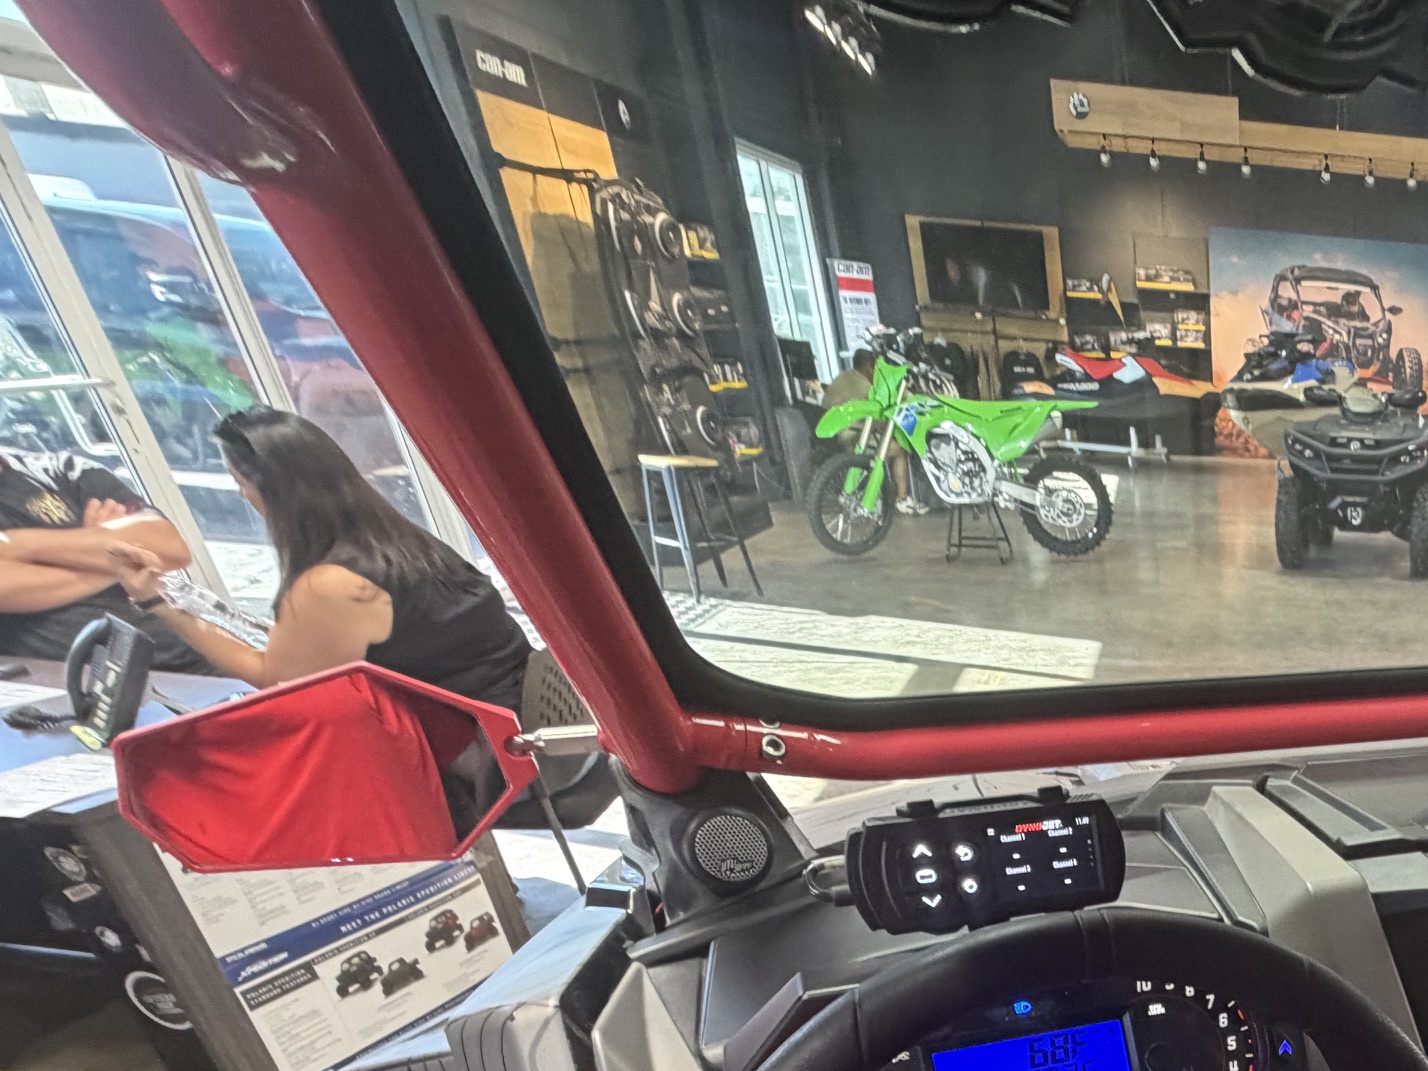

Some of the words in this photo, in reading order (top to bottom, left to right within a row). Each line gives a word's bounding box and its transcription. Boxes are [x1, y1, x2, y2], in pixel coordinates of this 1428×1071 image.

[1206, 994, 1215, 1010] 7
[1218, 1012, 1228, 1028] 6
[1029, 1030, 1087, 1069] 68F
[1227, 1035, 1237, 1051] 5
